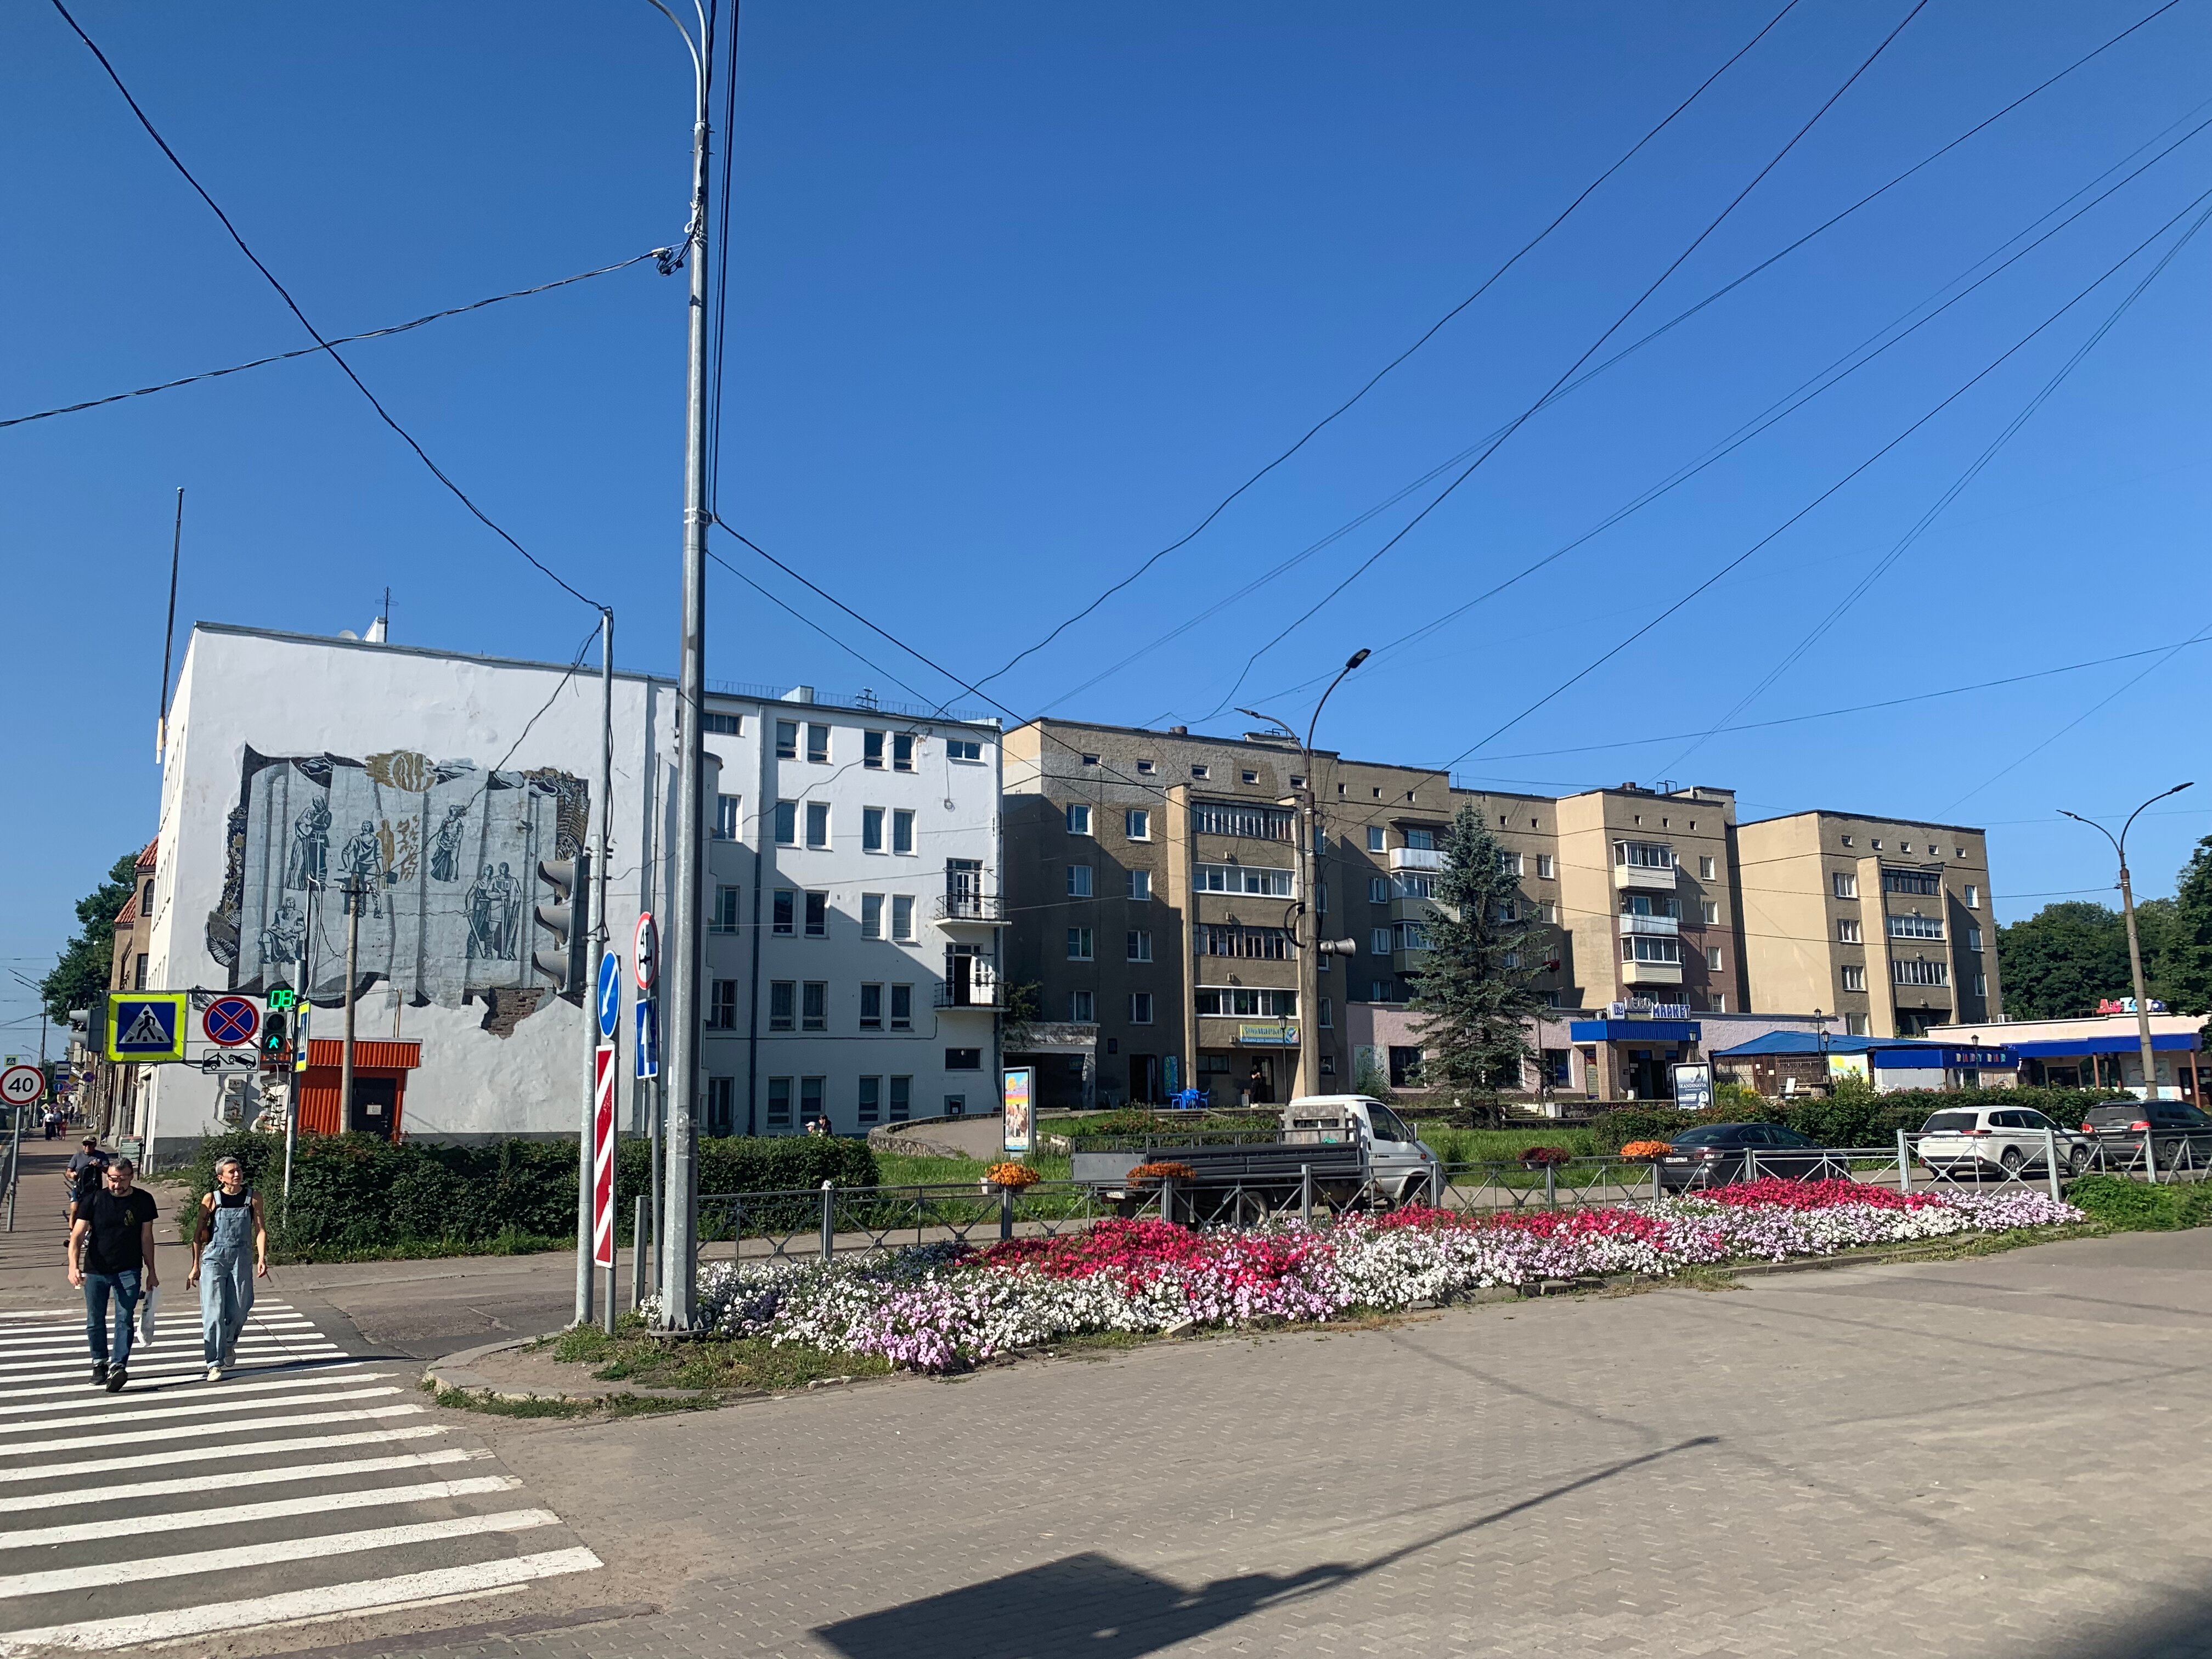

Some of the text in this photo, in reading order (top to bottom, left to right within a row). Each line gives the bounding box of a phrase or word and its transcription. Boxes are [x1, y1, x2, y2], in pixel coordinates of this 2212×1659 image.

[271, 990, 292, 1007] 08
[1652, 1002, 1690, 1019] МАРКЕТ
[1956, 1053, 2006, 1062] BABY BAR
[8, 1077, 33, 1092] 40
